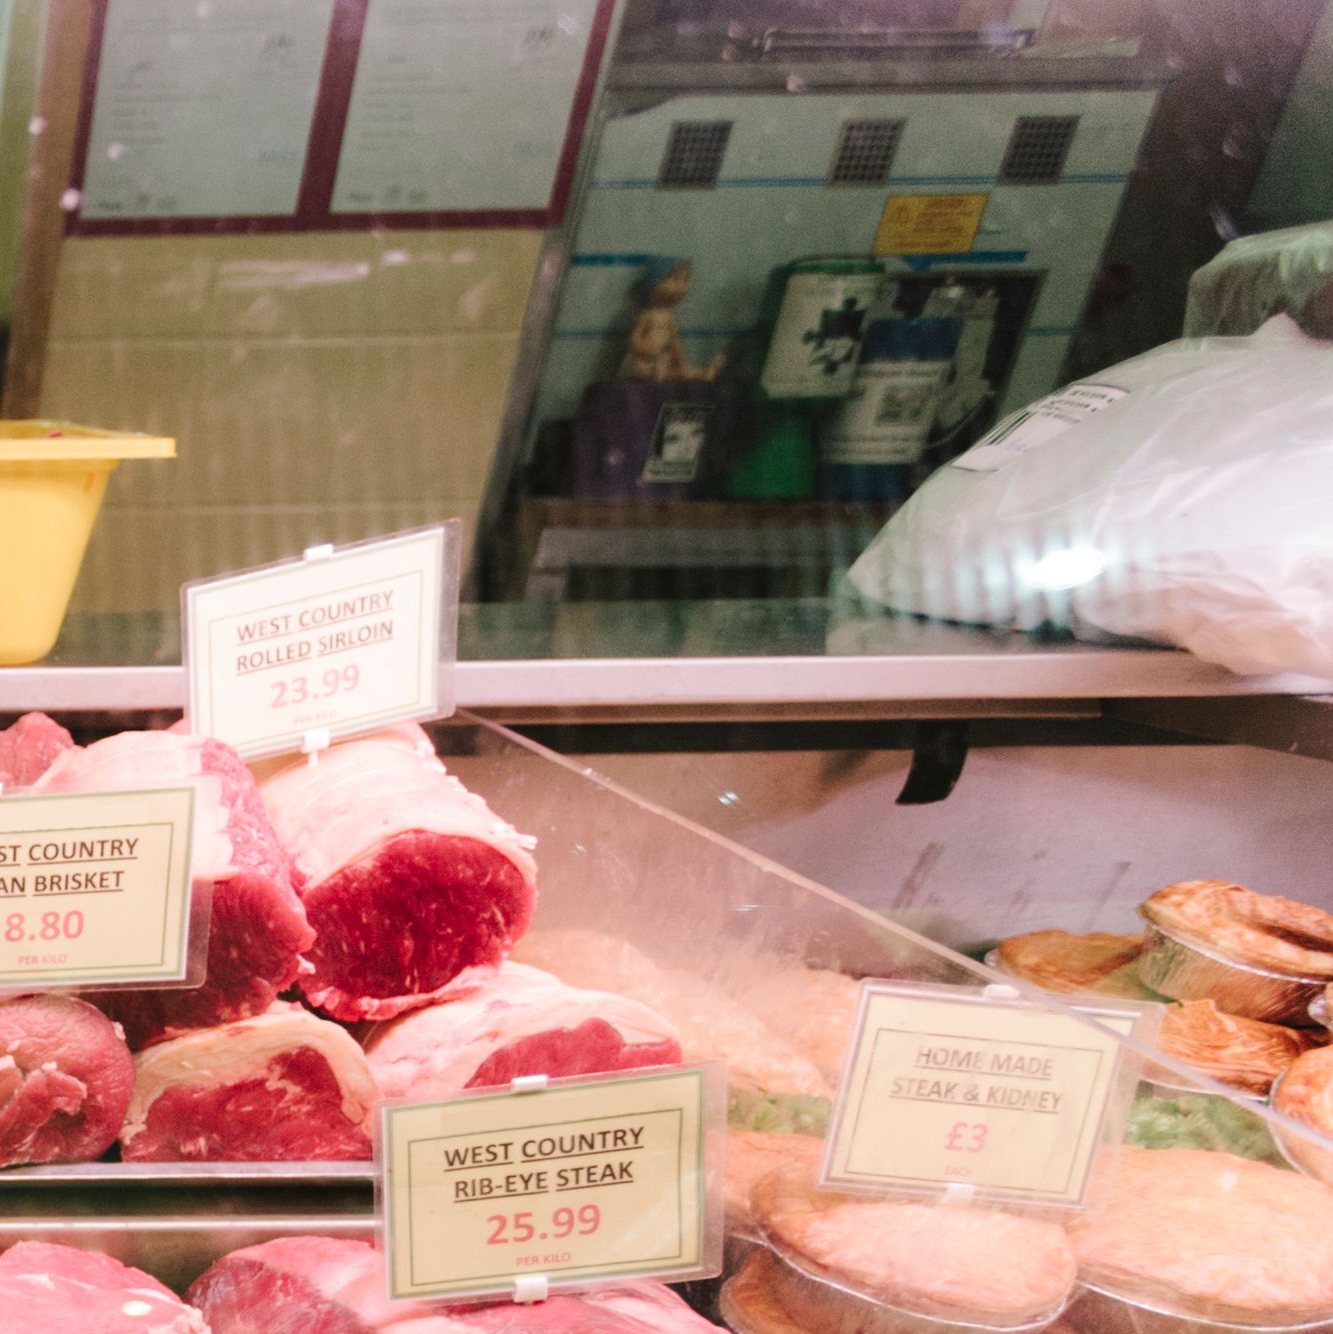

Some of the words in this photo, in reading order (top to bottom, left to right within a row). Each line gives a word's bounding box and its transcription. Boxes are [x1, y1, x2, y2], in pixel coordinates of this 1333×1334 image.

[237, 614, 292, 642] WEST
[299, 589, 394, 628] COUNTRY
[237, 641, 311, 671] ROLLED
[318, 620, 393, 652] SIRLOIN
[270, 663, 361, 709] 23.99
[28, 838, 139, 862] COUNTRY
[34, 871, 125, 892] BRISKET
[4, 910, 85, 942] 8.80
[18, 955, 39, 966] PER
[42, 953, 68, 965] KILO
[916, 1046, 983, 1071] HOME
[990, 1053, 1054, 1077] MADE
[890, 1077, 957, 1100] STEAK
[963, 1084, 980, 1102] &
[986, 1086, 1065, 1112] KIDNEY
[444, 1142, 513, 1167] WEST
[521, 1126, 644, 1159] COUNTRY
[944, 1122, 989, 1152] £3
[454, 1171, 548, 1198] RIB-EYE
[556, 1160, 633, 1187] STEAK
[486, 1204, 601, 1246] 25.99
[516, 1255, 539, 1267] PER
[543, 1252, 571, 1264] KILO
